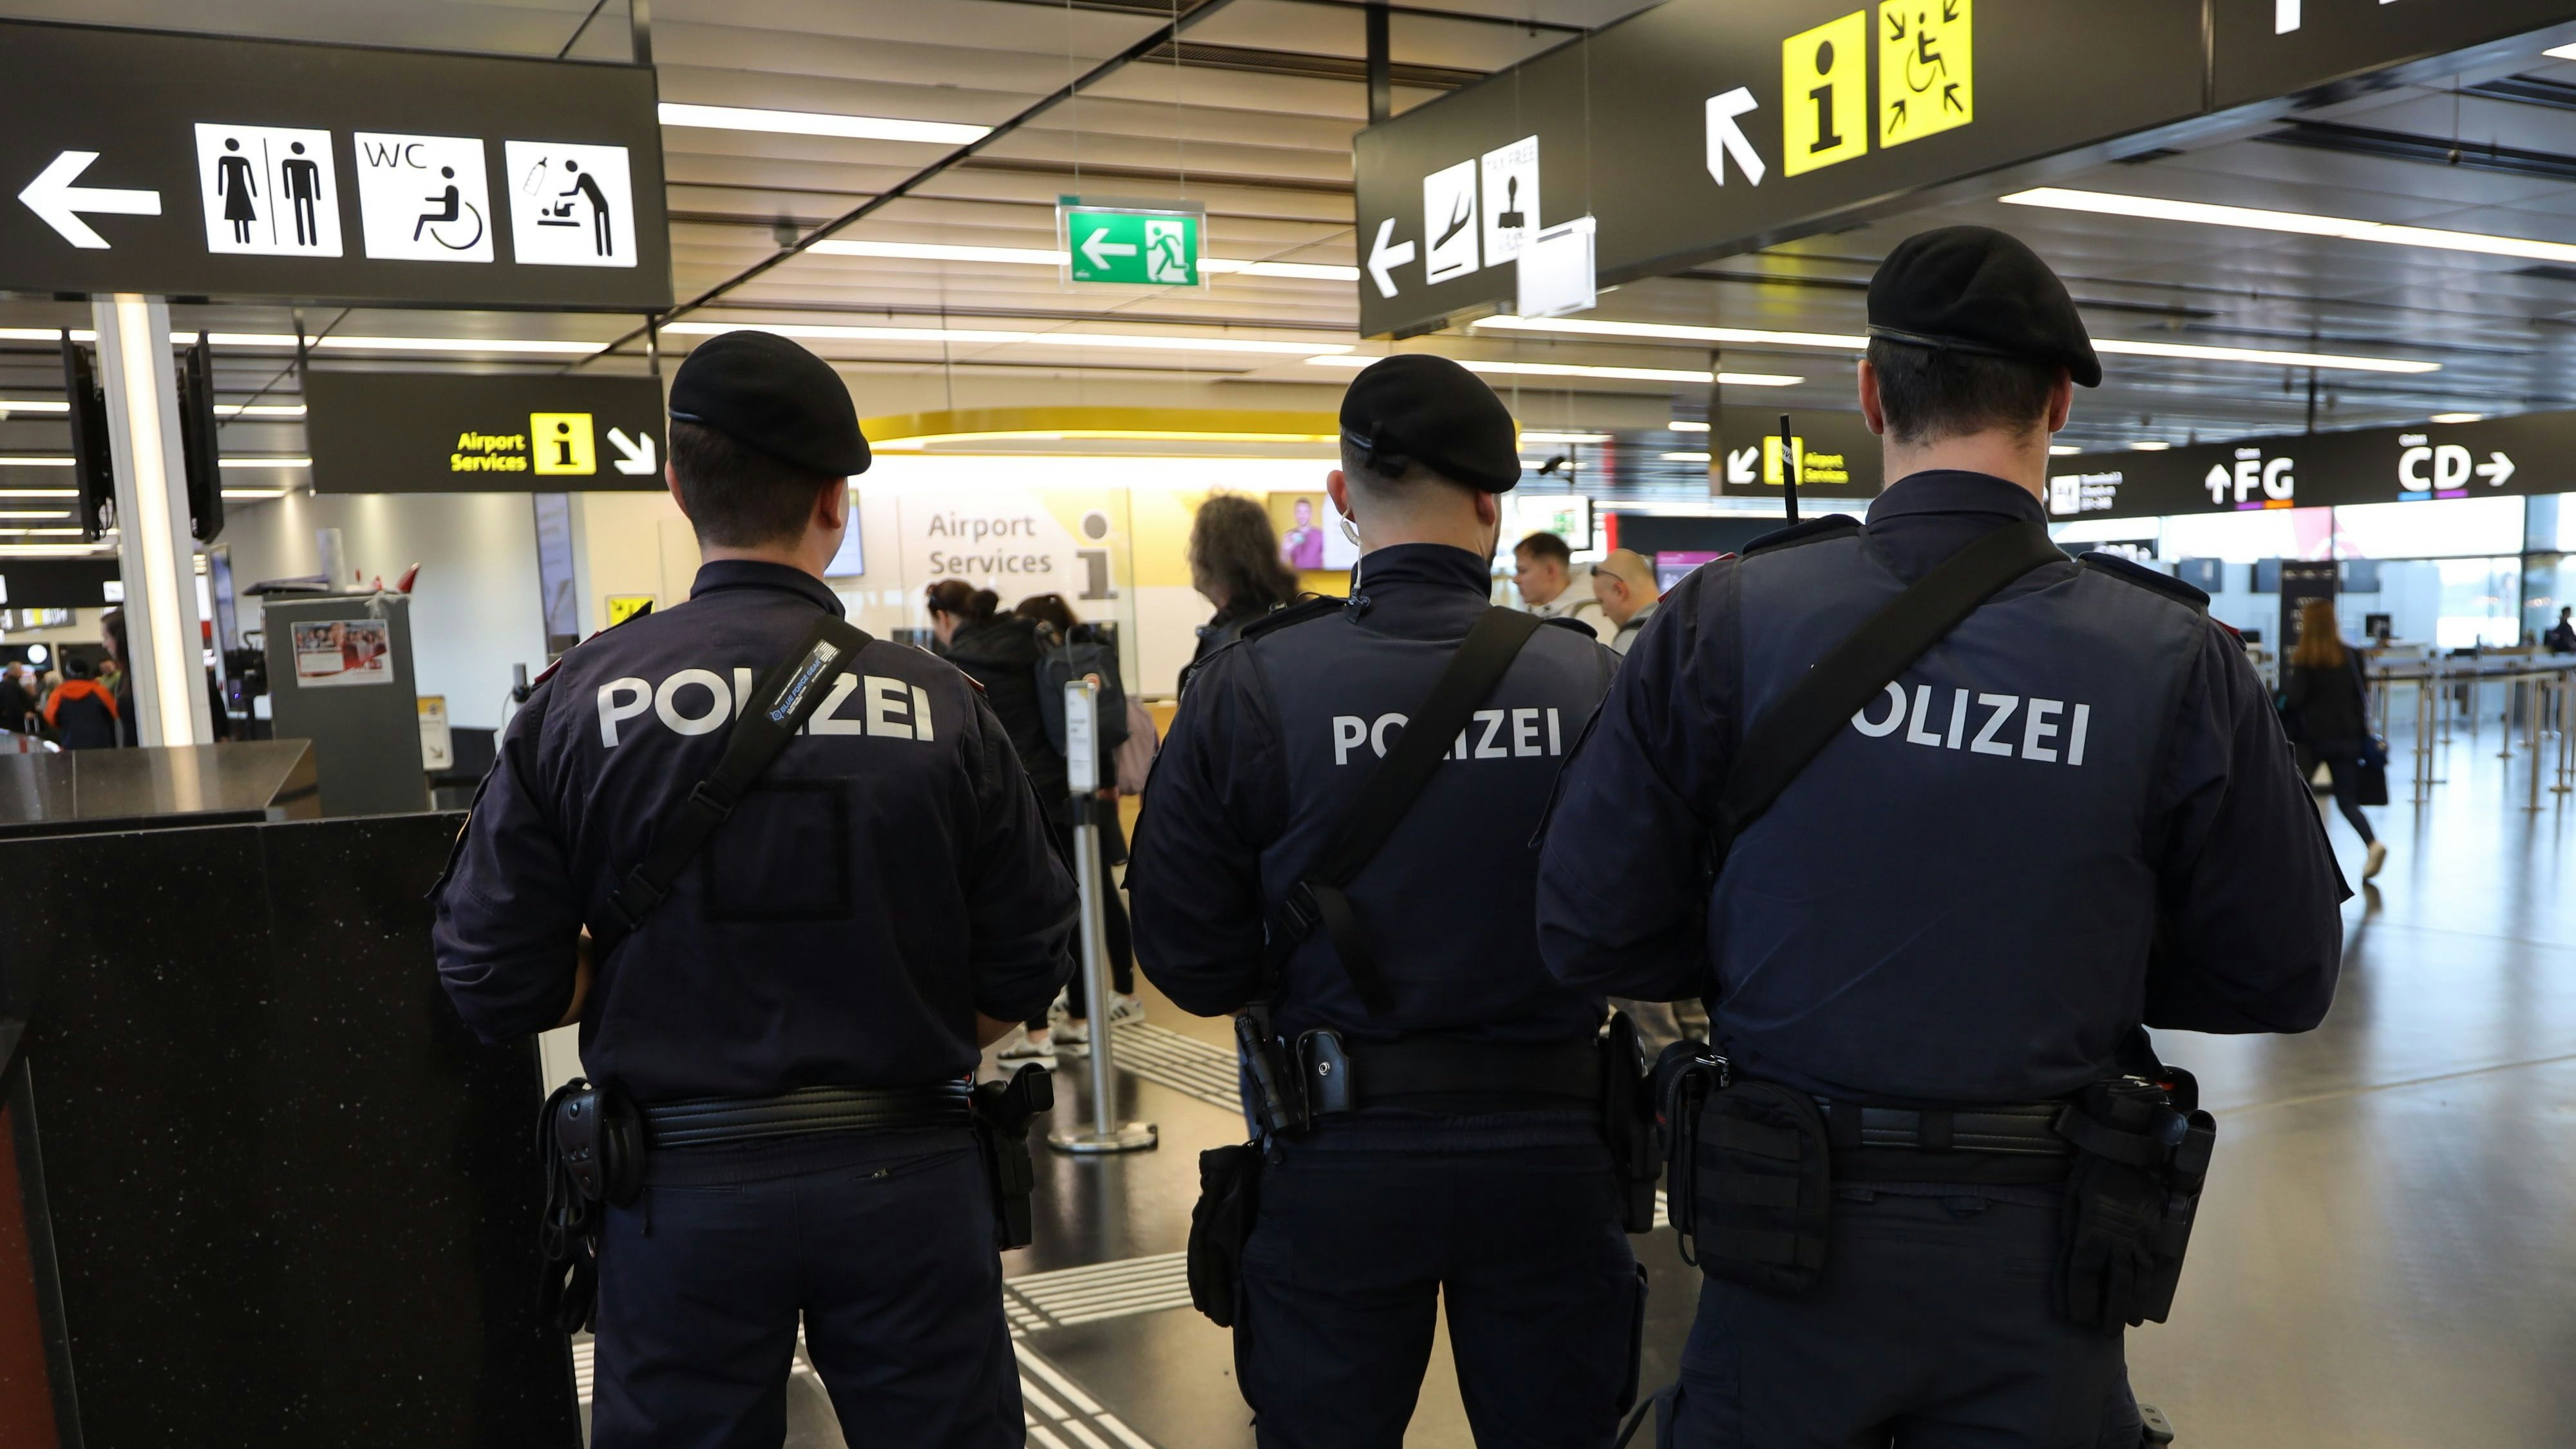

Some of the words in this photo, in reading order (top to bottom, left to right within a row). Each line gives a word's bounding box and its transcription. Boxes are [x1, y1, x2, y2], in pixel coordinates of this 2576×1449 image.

[363, 142, 427, 169] WC
[457, 431, 527, 453] Airport
[450, 452, 528, 472] Services
[1804, 451, 1844, 469] Airport
[2398, 444, 2472, 492] CD
[1803, 468, 1849, 484] Services
[2234, 457, 2295, 503] FG
[928, 512, 1037, 543] Airport
[929, 548, 1052, 574] Services
[780, 694, 794, 714] BLUE
[791, 674, 810, 696] FORCE
[806, 658, 822, 676] GEAR
